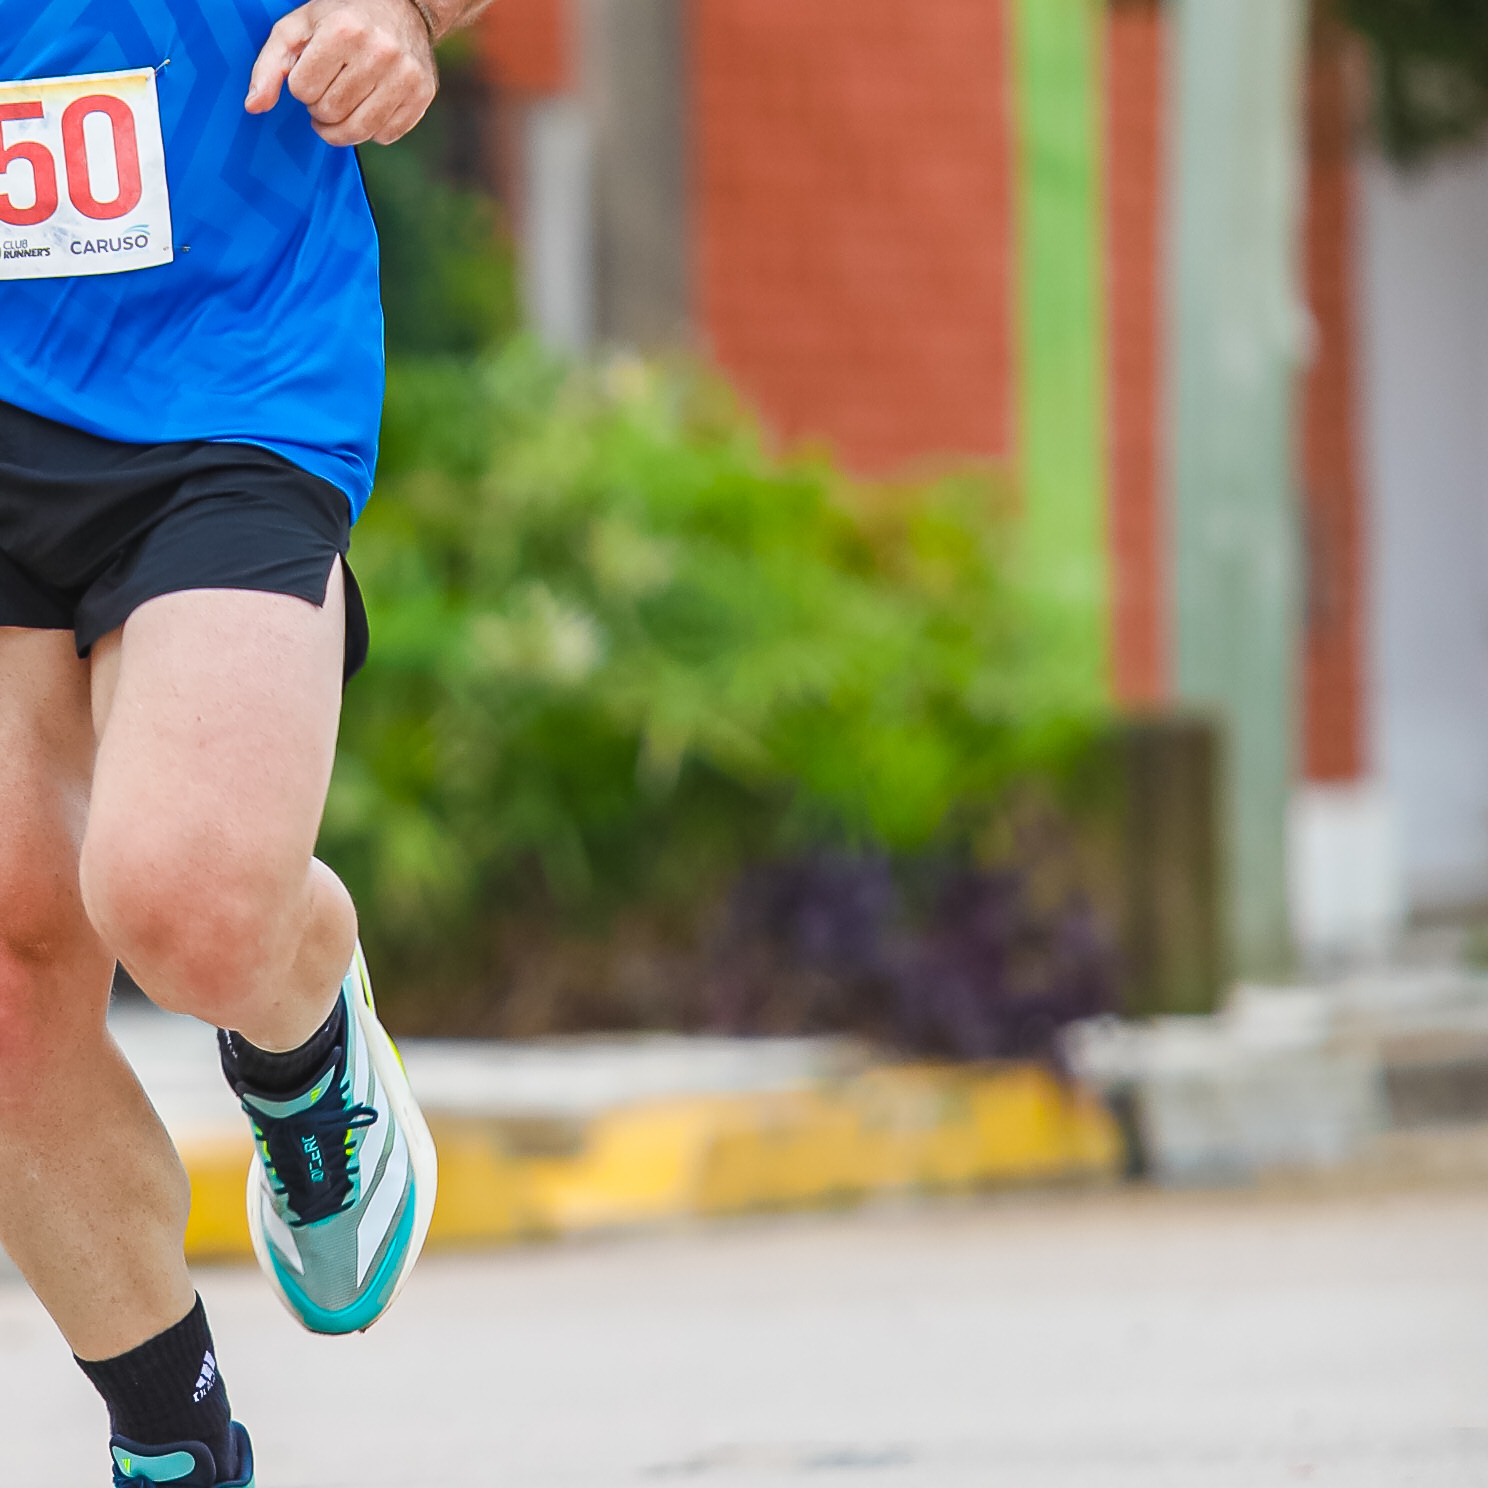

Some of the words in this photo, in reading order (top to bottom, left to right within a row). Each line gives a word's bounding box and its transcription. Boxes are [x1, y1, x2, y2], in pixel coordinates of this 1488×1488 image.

[3, 239, 28, 250] CLUB
[70, 234, 149, 255] CARUSO
[3, 247, 51, 259] RUNNER'S
